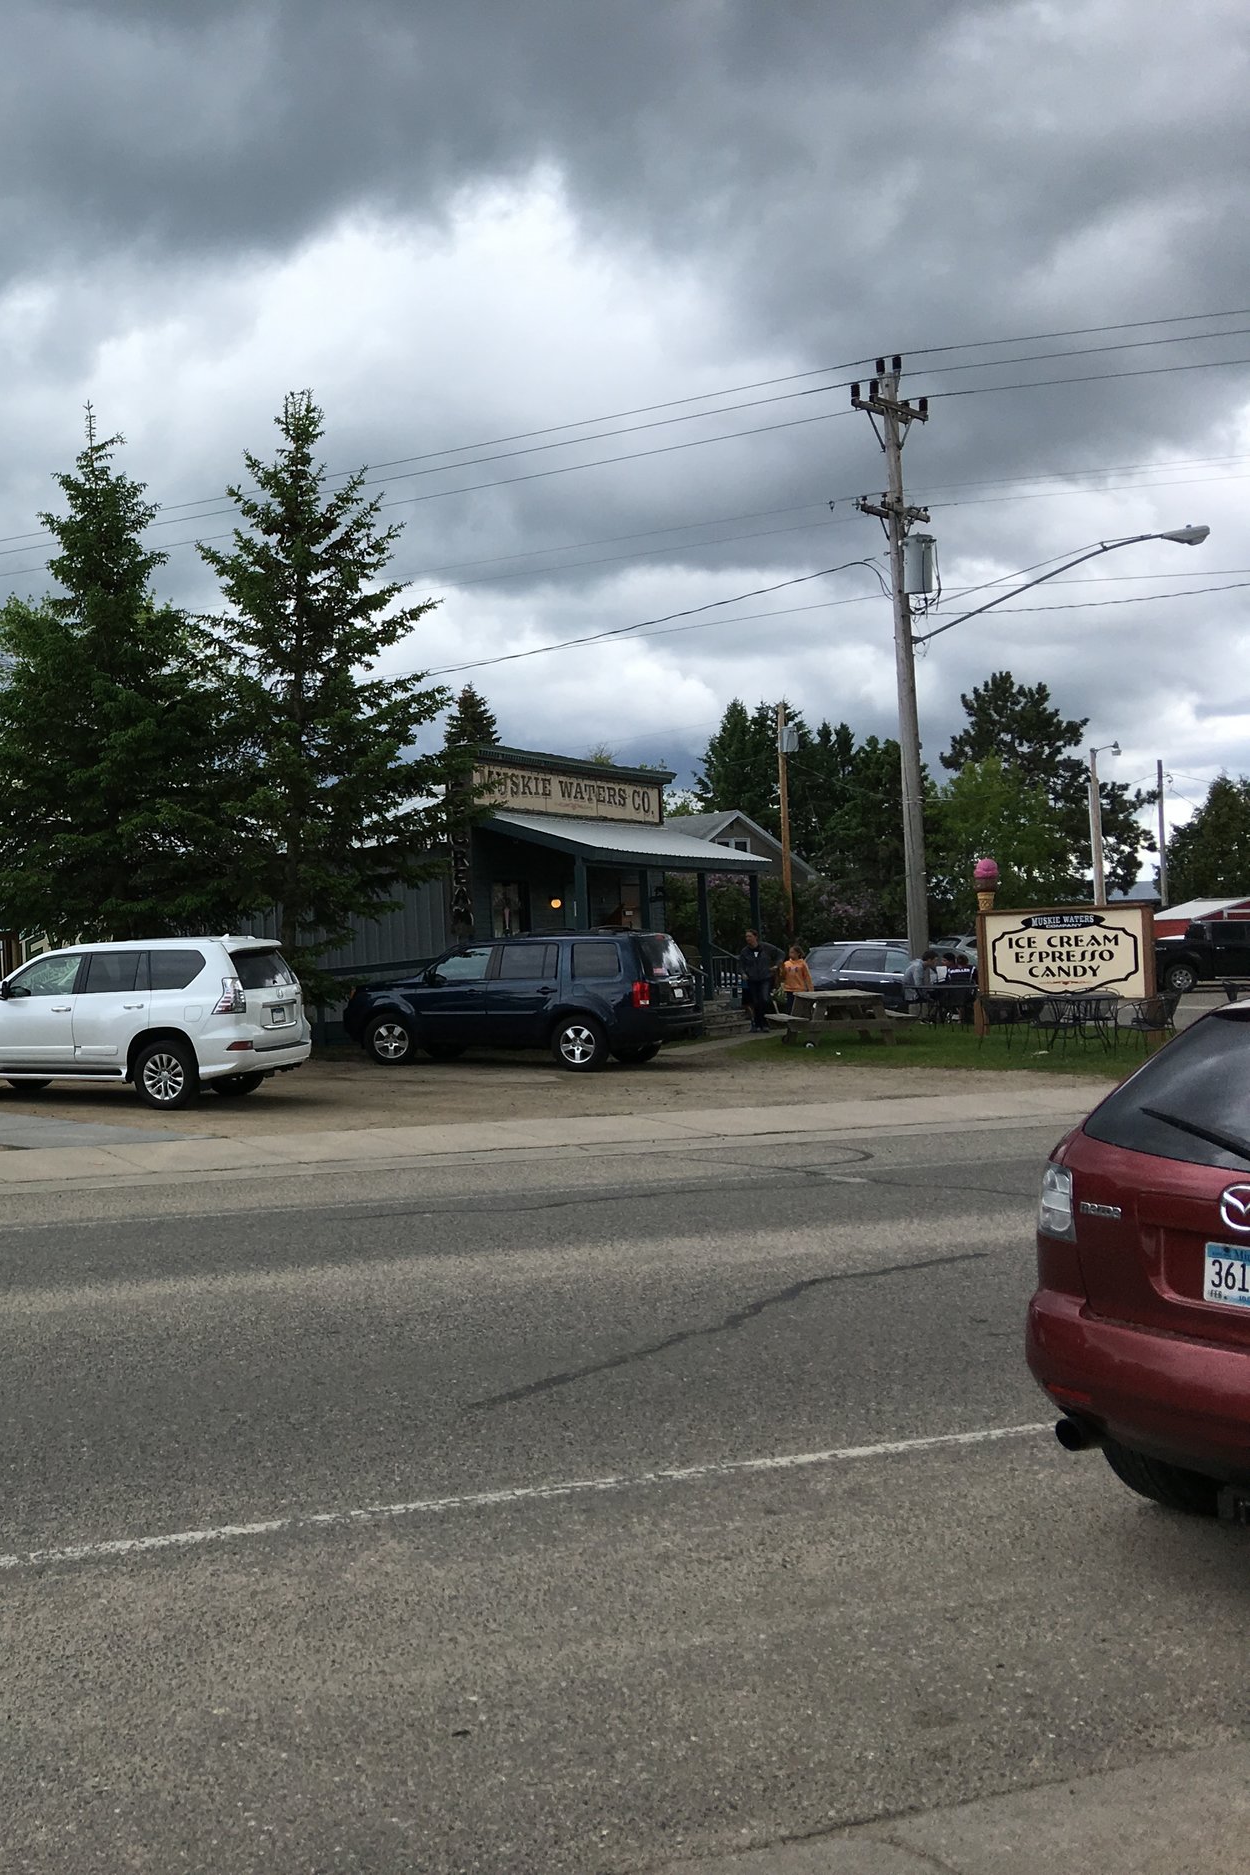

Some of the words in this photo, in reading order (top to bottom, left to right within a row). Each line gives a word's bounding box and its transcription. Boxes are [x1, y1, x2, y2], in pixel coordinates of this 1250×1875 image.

[558, 780, 627, 807] WATERS
[631, 790, 655, 814] CO.
[1031, 915, 1061, 927] MUSKIE
[1062, 914, 1095, 924] WATERS
[1008, 936, 1037, 949] ICE
[1046, 934, 1119, 948] CREAM
[1014, 949, 1114, 963] ESPRESSO
[1028, 964, 1101, 978] CANDY
